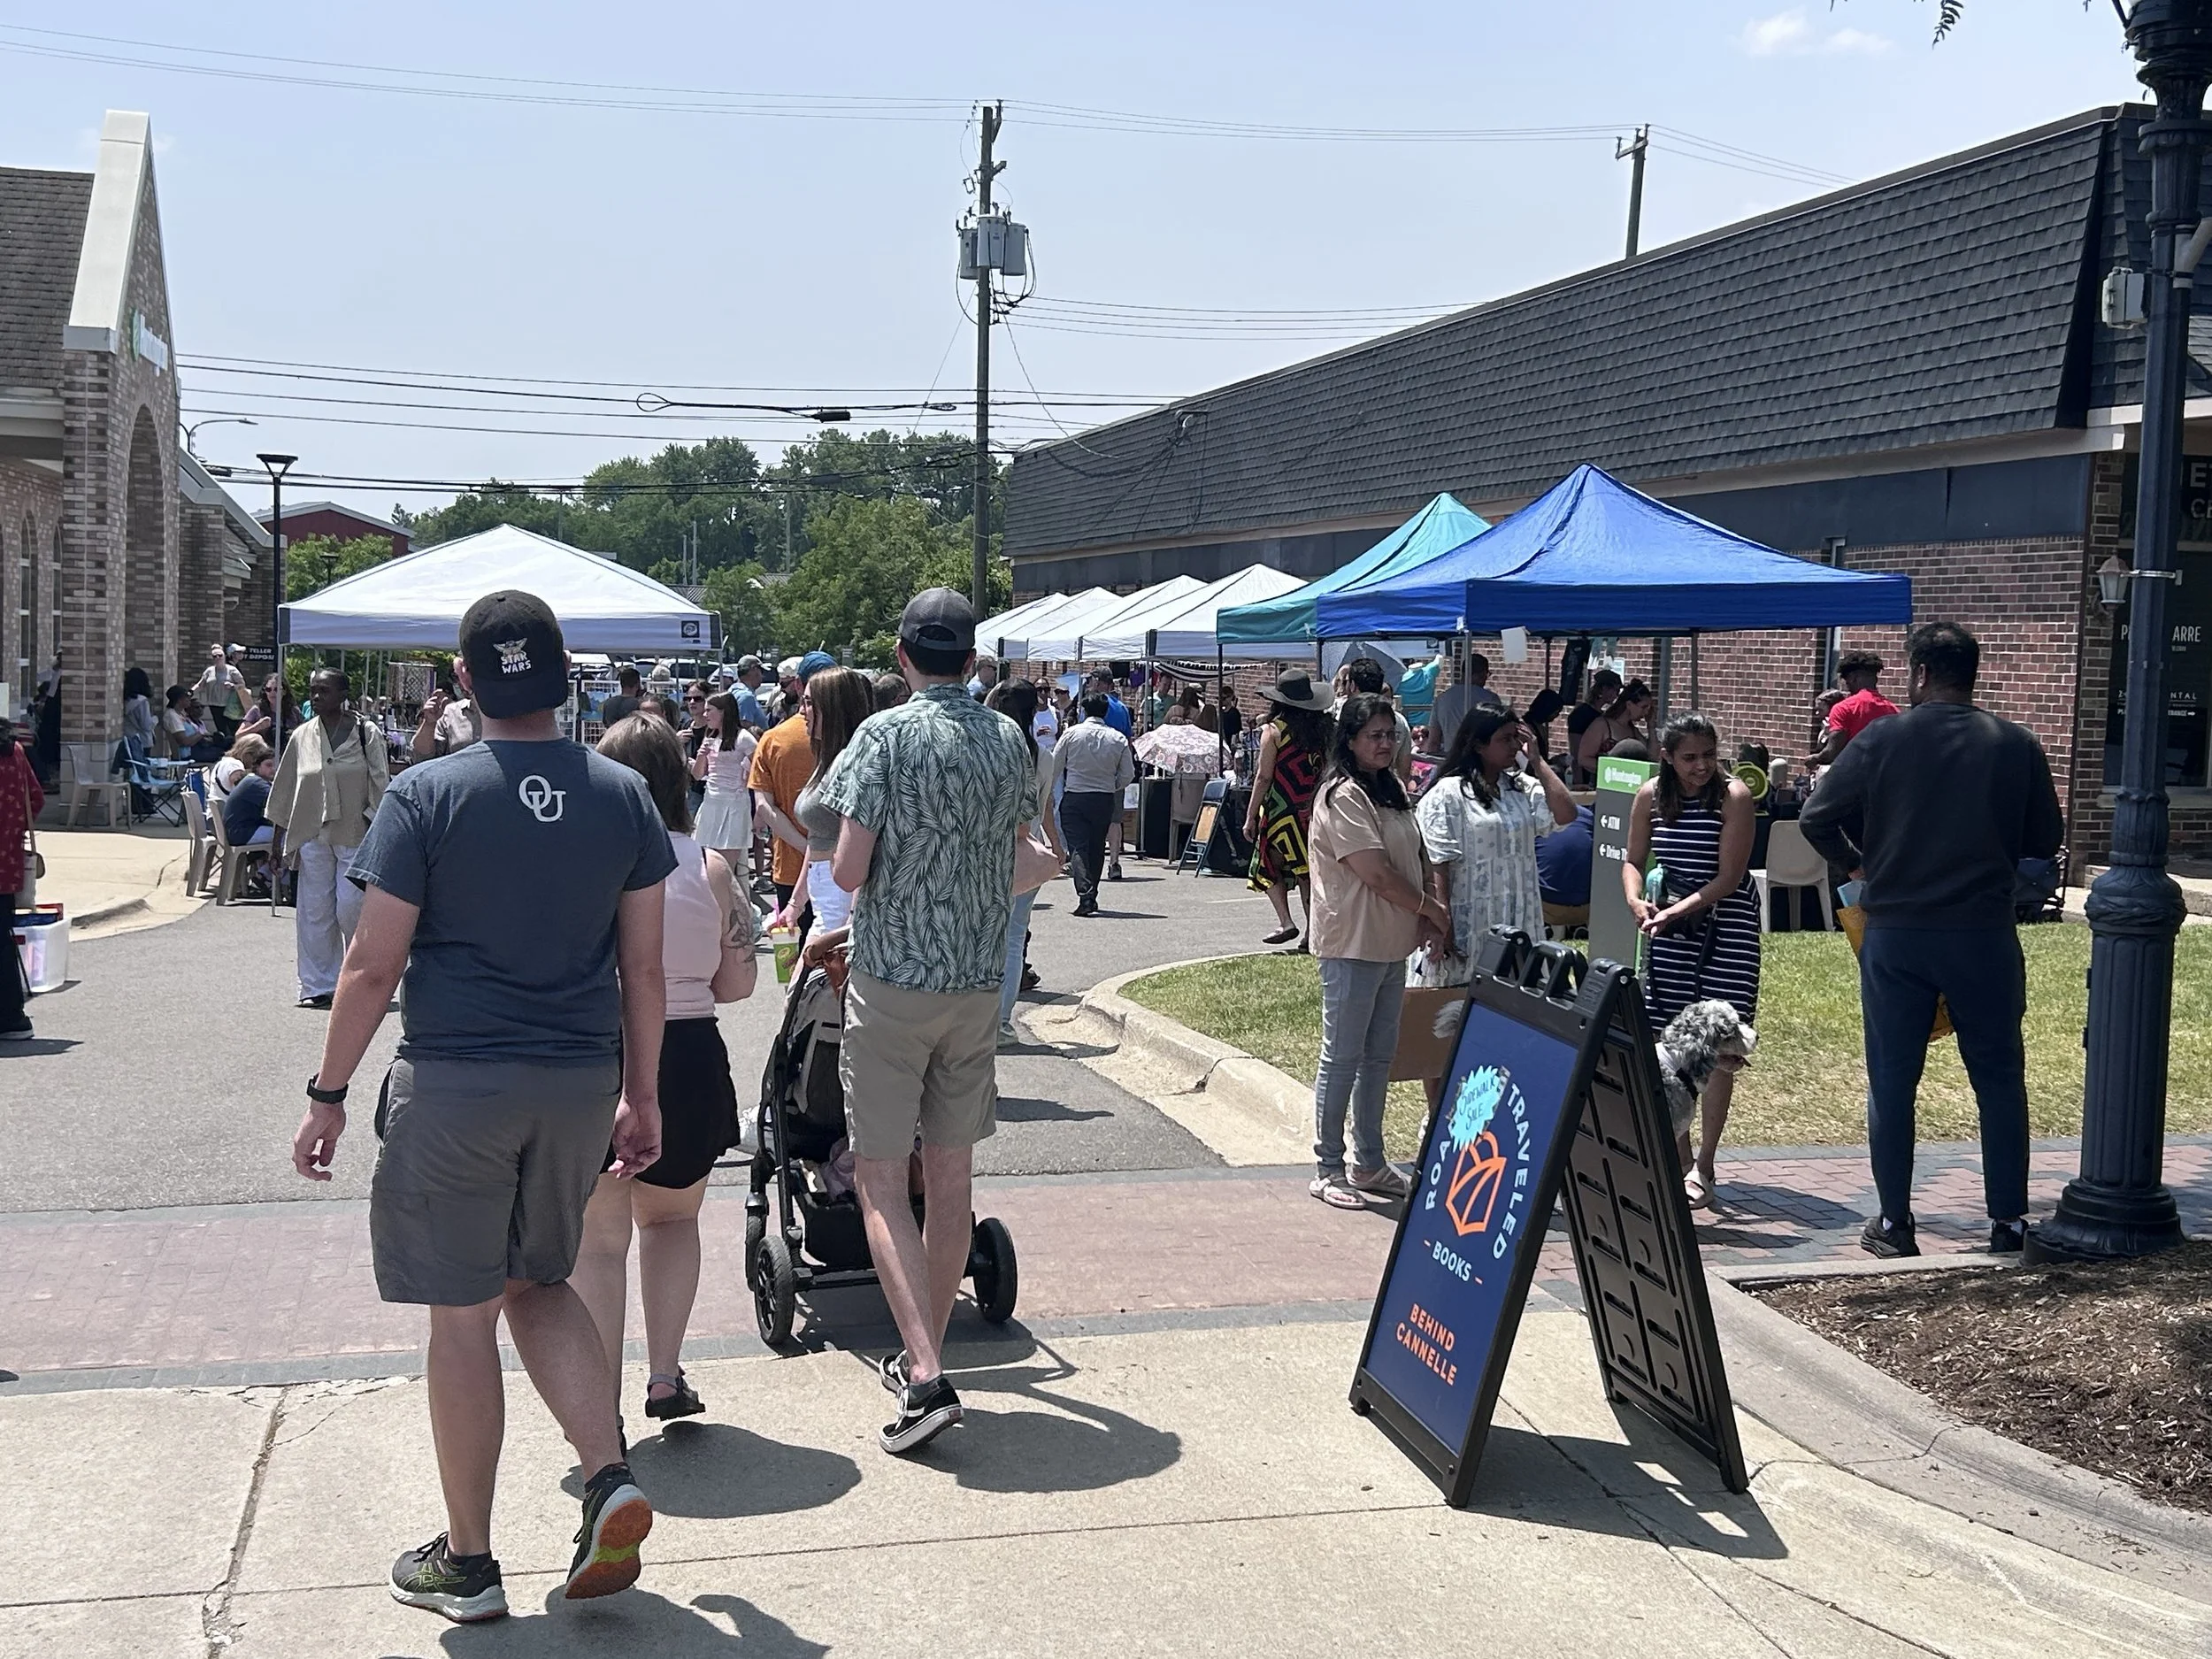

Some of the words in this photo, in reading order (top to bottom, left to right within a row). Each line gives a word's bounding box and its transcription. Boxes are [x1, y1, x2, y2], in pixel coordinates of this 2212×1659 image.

[2171, 625, 2202, 642] ARRE
[501, 650, 528, 664] STAR
[502, 660, 532, 673] WARS
[2170, 691, 2197, 700] NTAL
[518, 774, 566, 822] OU
[1607, 816, 1621, 830] ATM
[1606, 844, 1621, 861] Drive
[1465, 1102, 1485, 1131] SALE
[1425, 1140, 1451, 1210] ROA
[1493, 1082, 1530, 1259] TRAVELED
[1432, 1240, 1472, 1281] BOOKS
[1409, 1302, 1455, 1352] BEHIND
[1396, 1322, 1457, 1386] CANNELLE
